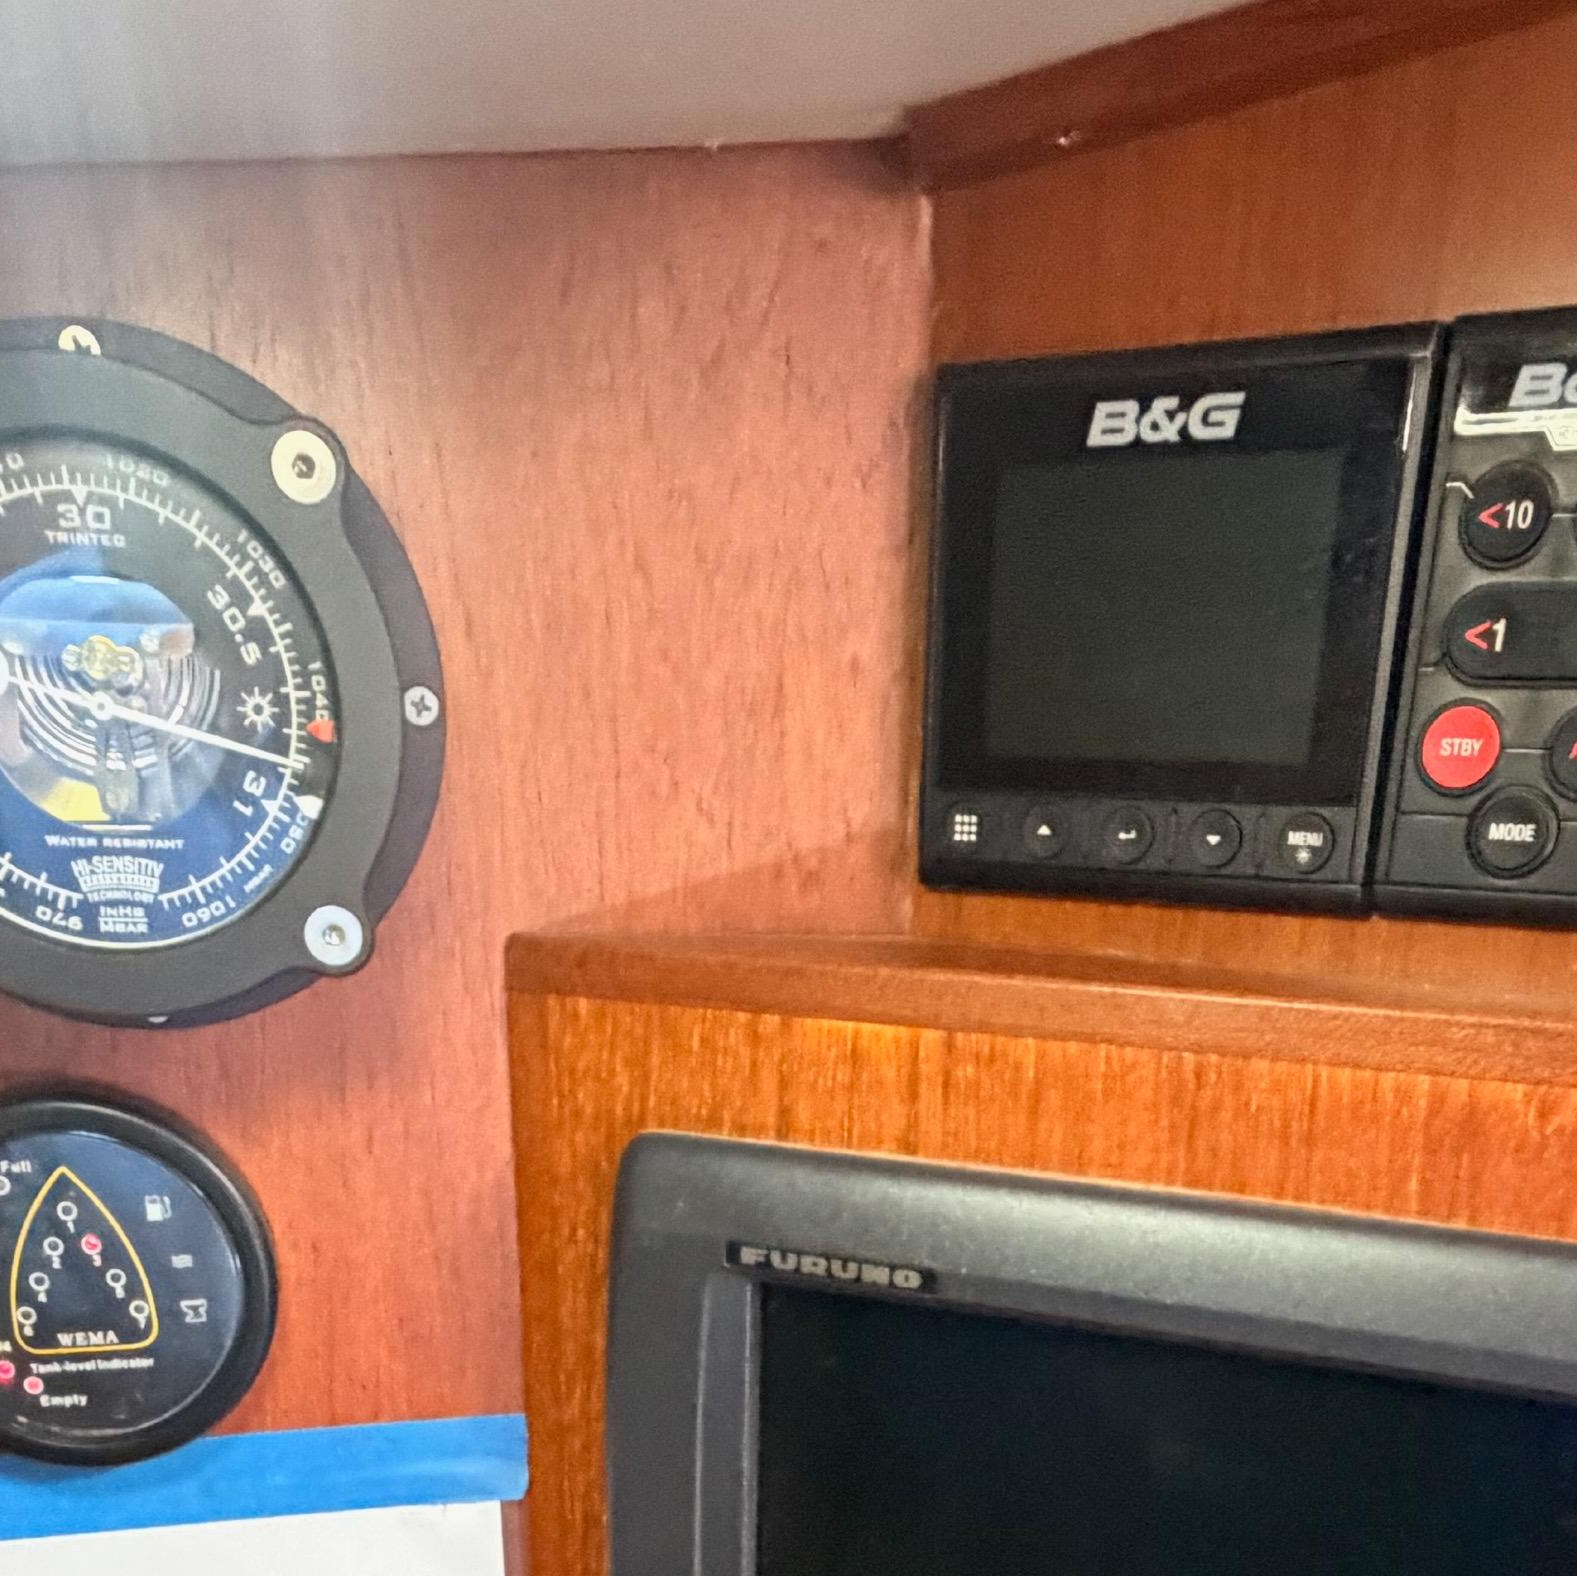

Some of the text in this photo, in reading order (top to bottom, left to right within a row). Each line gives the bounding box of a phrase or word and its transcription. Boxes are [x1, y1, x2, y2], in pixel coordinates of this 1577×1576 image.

[1086, 390, 1246, 450] B&G
[105, 454, 169, 488] 1020
[56, 503, 111, 531] 30
[43, 529, 126, 549] TRINTEC
[236, 528, 287, 590] 1030
[207, 583, 264, 666] 30.5
[1439, 736, 1484, 760] STBY
[232, 769, 267, 817] 31
[44, 834, 185, 850] WATER RESISTANT
[1287, 829, 1324, 850] MENU
[1488, 821, 1535, 844] MODE
[70, 855, 165, 877] HI-SENSITIV
[181, 895, 236, 928] 1060
[0, 1160, 32, 1173] Full
[740, 1245, 923, 1290] FURUNO
[56, 1330, 120, 1347] WEMA
[39, 1394, 88, 1408] Empty
